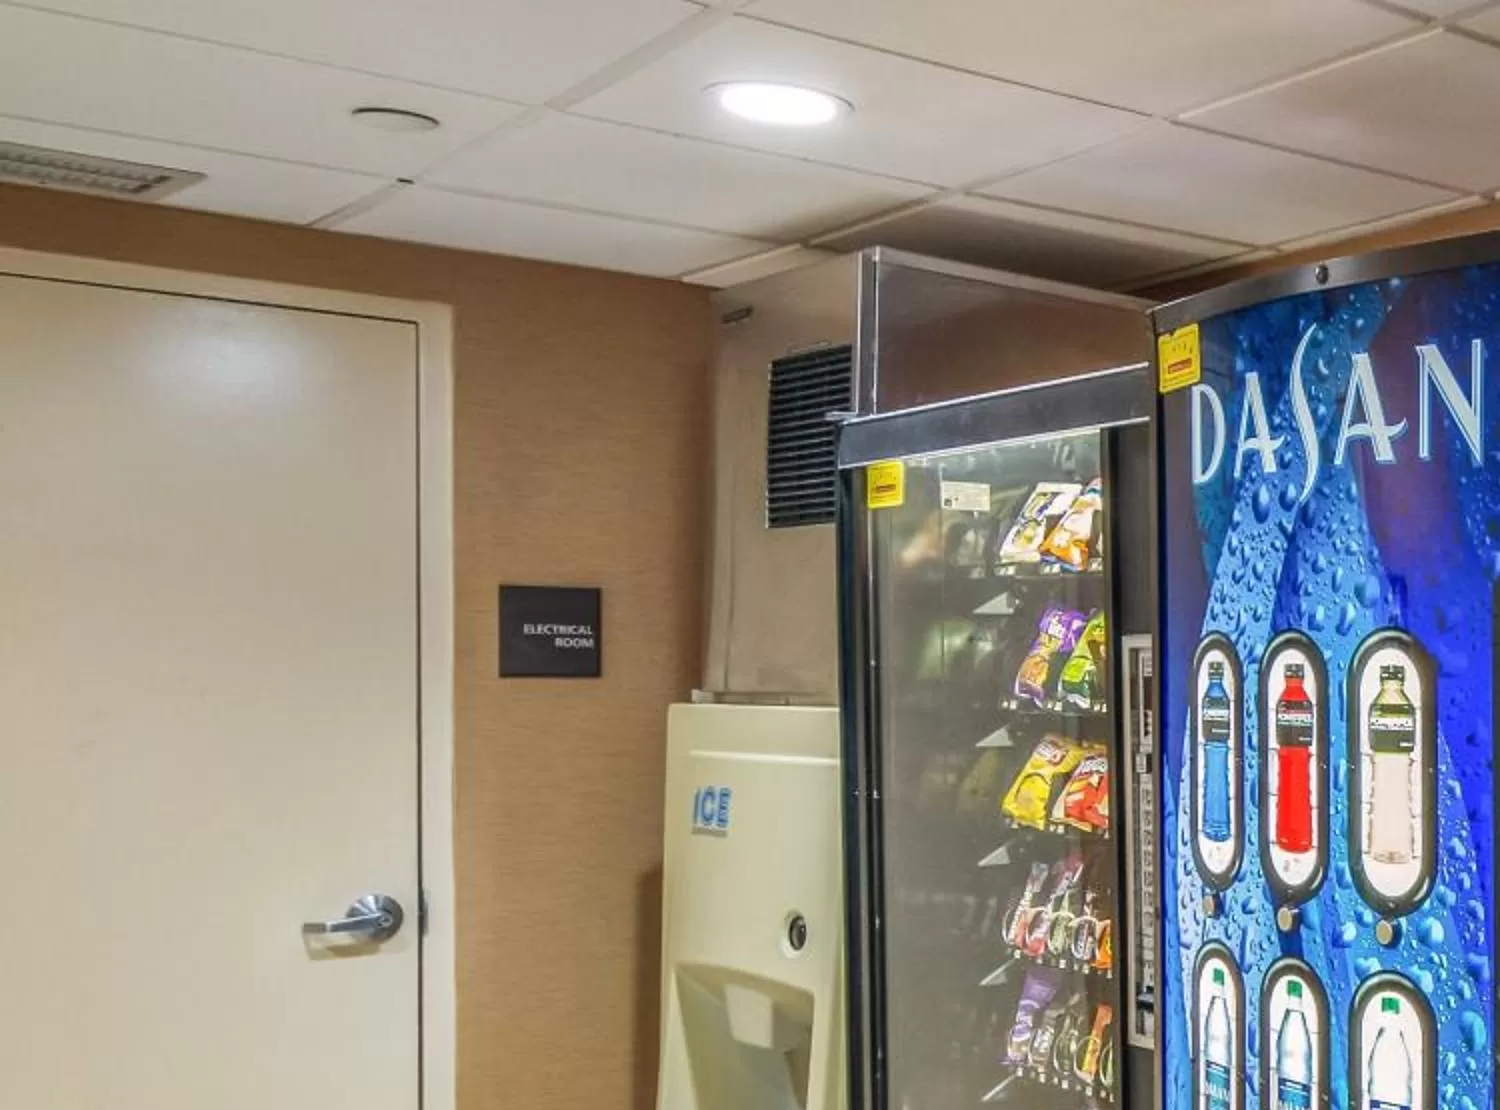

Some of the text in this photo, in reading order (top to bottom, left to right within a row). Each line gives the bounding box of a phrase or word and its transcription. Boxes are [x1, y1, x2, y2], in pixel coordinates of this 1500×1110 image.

[523, 623, 593, 636] ELECTRICAL
[554, 637, 595, 649] ROOM
[693, 785, 732, 828] ICE
